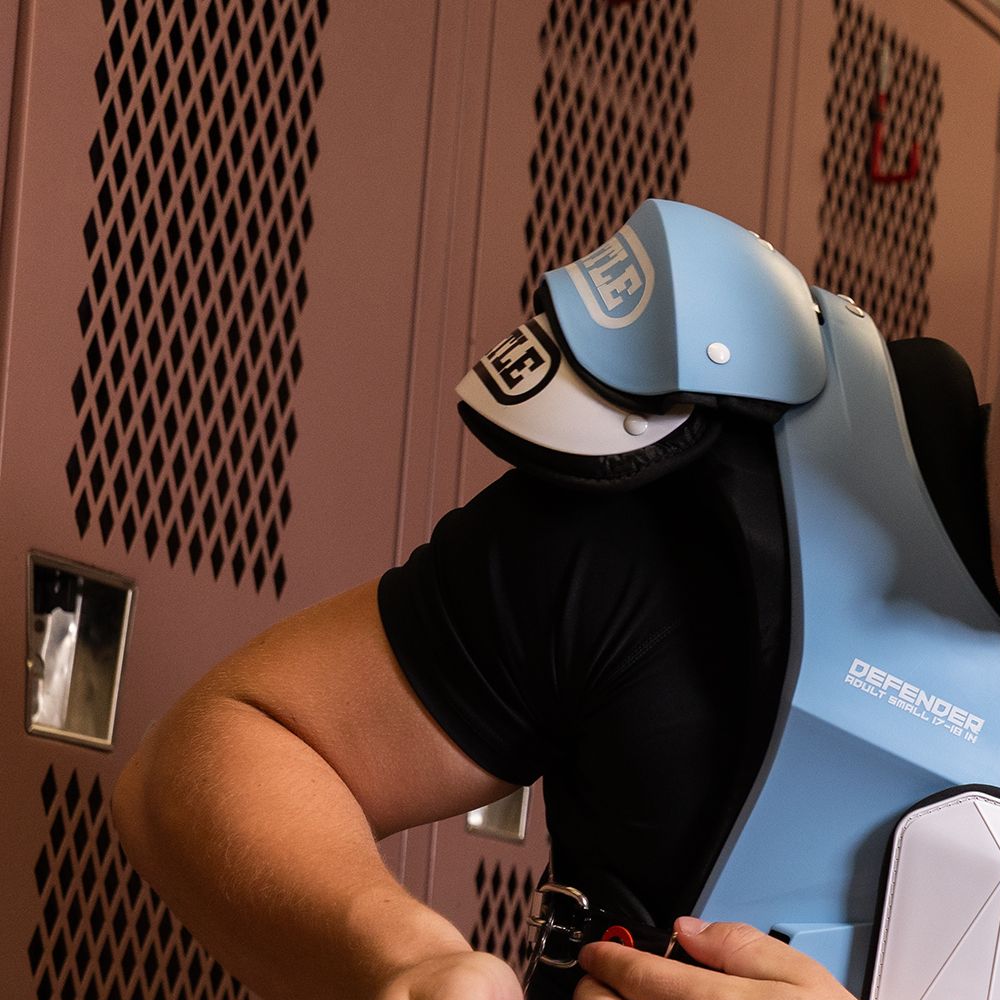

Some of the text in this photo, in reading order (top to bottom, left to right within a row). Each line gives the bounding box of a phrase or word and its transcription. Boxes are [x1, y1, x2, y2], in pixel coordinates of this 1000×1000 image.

[582, 236, 643, 312] TLE
[486, 327, 546, 390] TLE
[844, 674, 978, 744] ADULT SMALL 17-18 IN
[848, 658, 986, 735] DEFENDER
